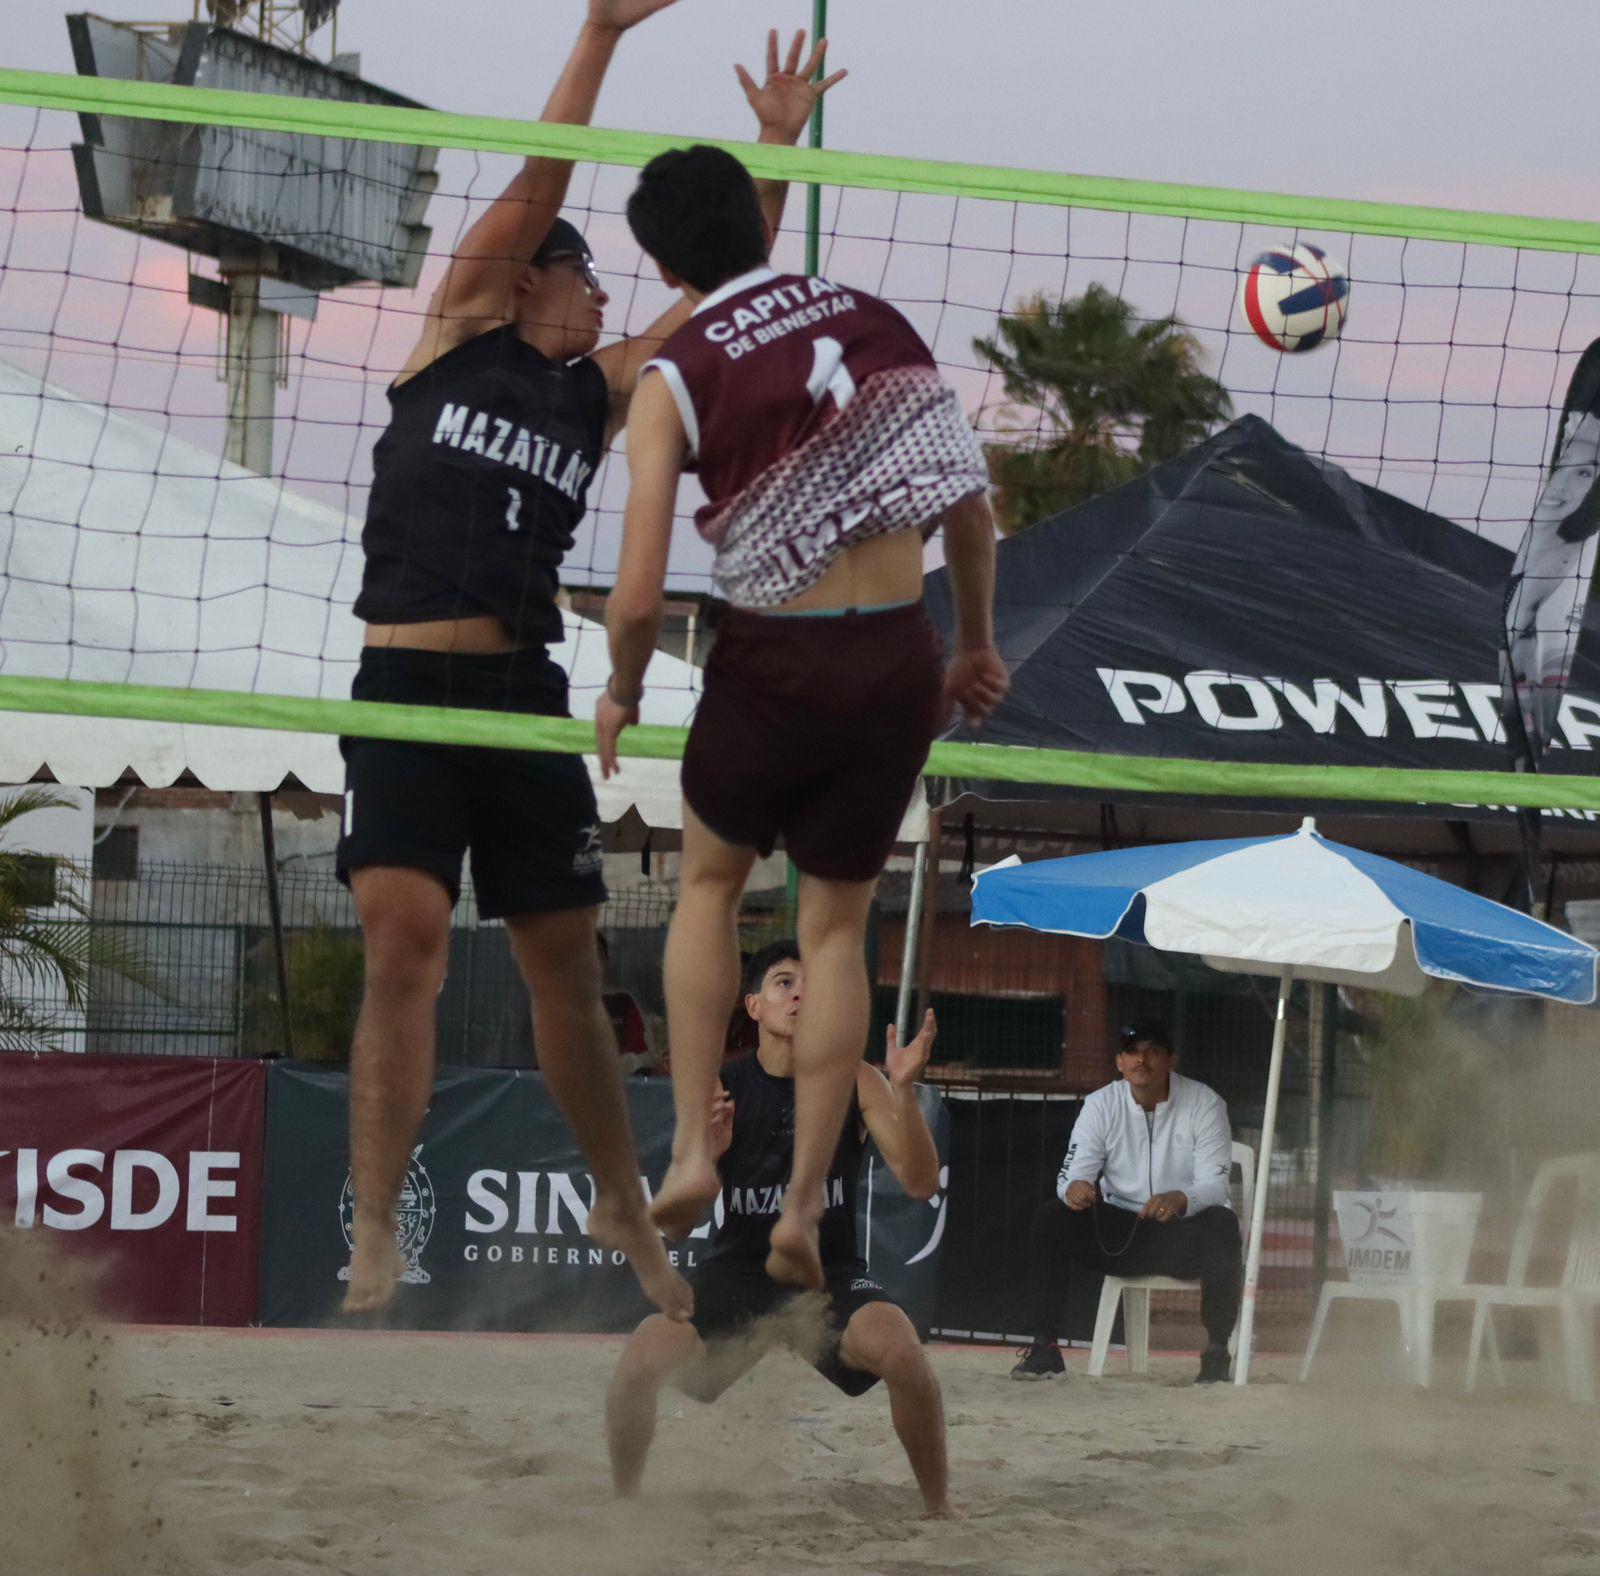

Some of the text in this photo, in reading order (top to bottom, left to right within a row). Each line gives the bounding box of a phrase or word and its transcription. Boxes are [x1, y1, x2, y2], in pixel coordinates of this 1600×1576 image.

[724, 294, 858, 360] DE BIENESTAR
[15, 1148, 241, 1232] ISDE
[464, 1245, 698, 1267] GOBIERNO EL
[1349, 1248, 1411, 1270] IMDEM
